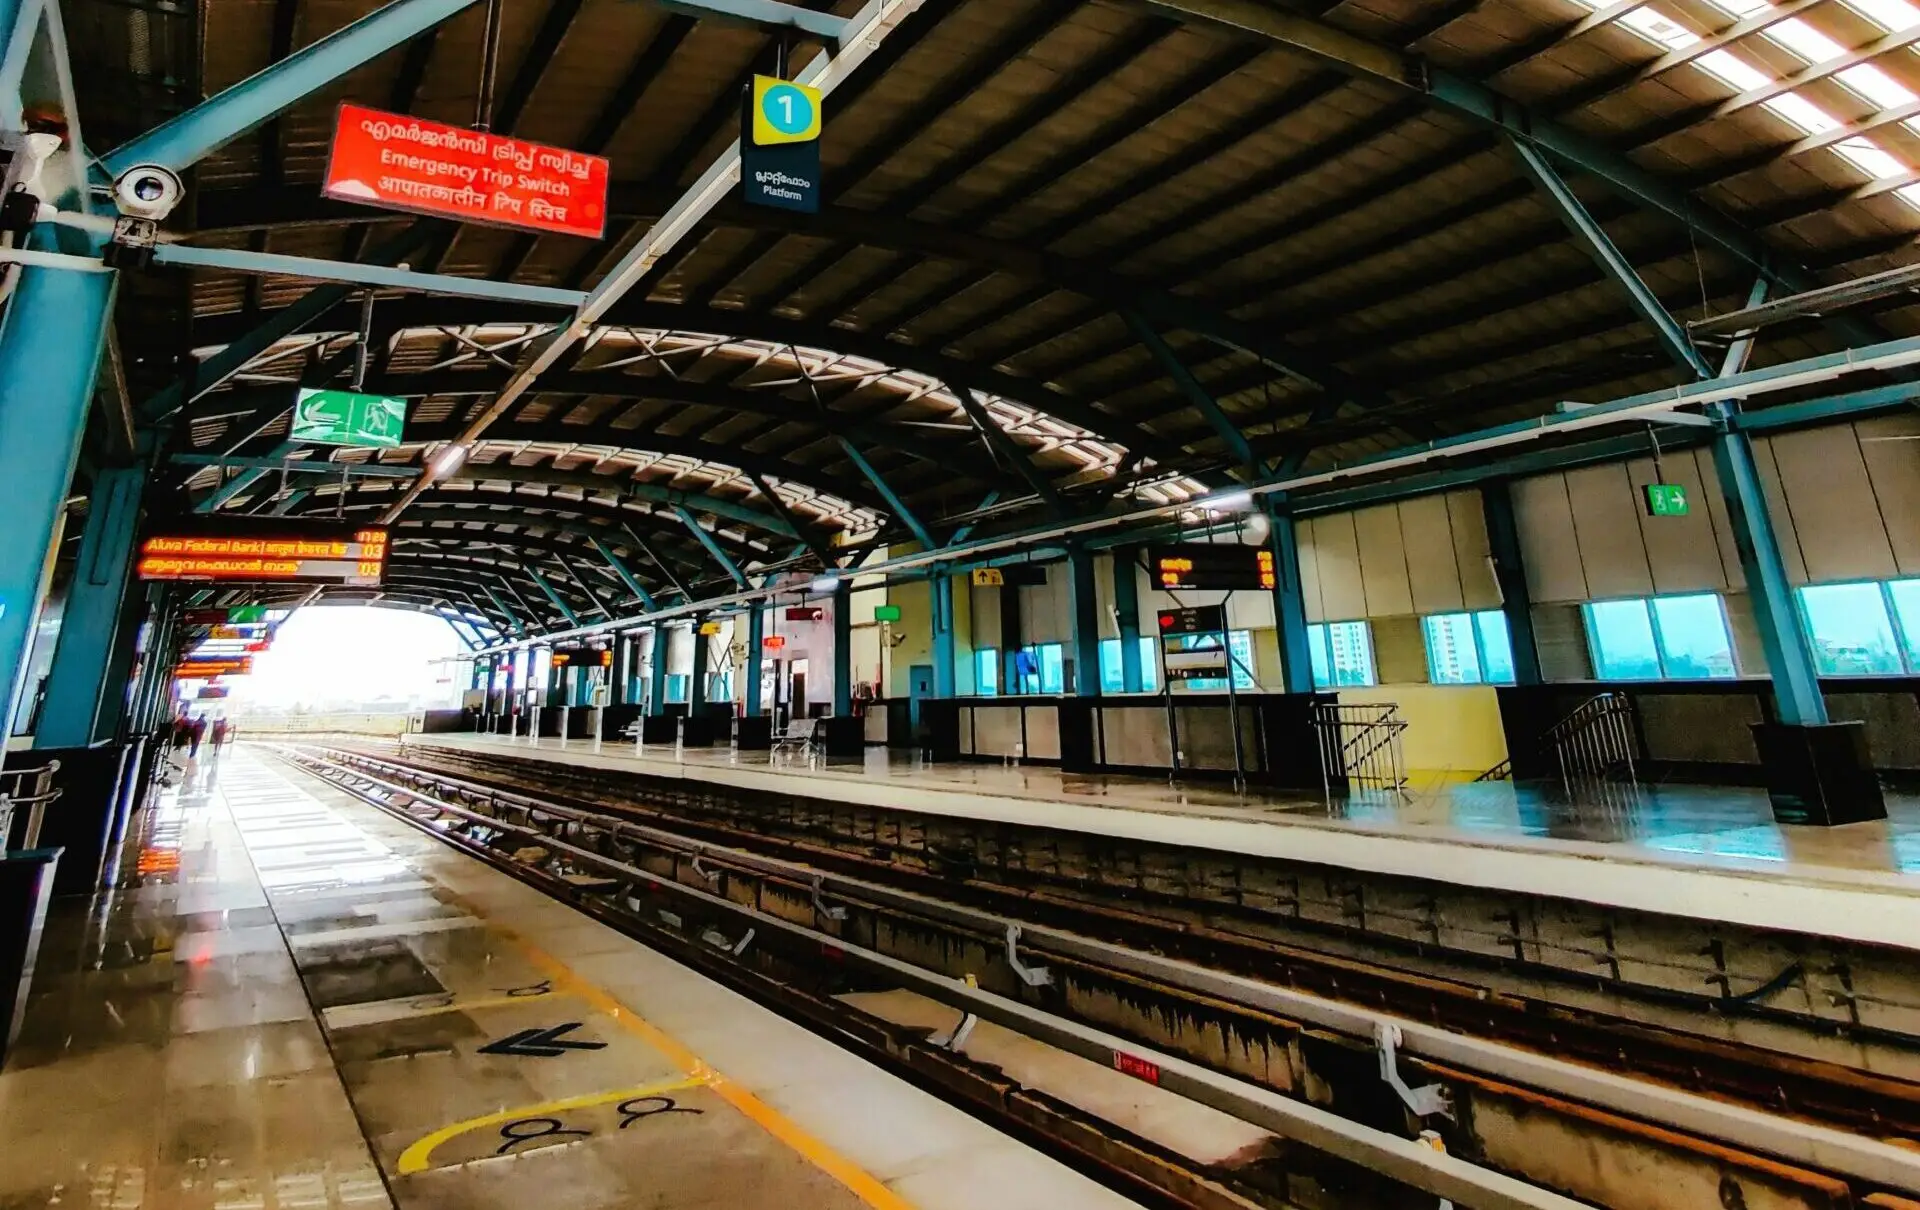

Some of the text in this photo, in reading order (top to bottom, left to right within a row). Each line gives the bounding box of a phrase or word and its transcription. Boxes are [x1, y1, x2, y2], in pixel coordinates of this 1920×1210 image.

[777, 95, 792, 124] 1
[381, 148, 571, 197] Emergency Trip Switch
[378, 175, 486, 209] आपातकालीन
[529, 199, 567, 222] स्विच
[763, 185, 802, 201] Platform
[147, 538, 182, 552] Aluva
[184, 539, 230, 553] Federal
[364, 544, 384, 558] 03
